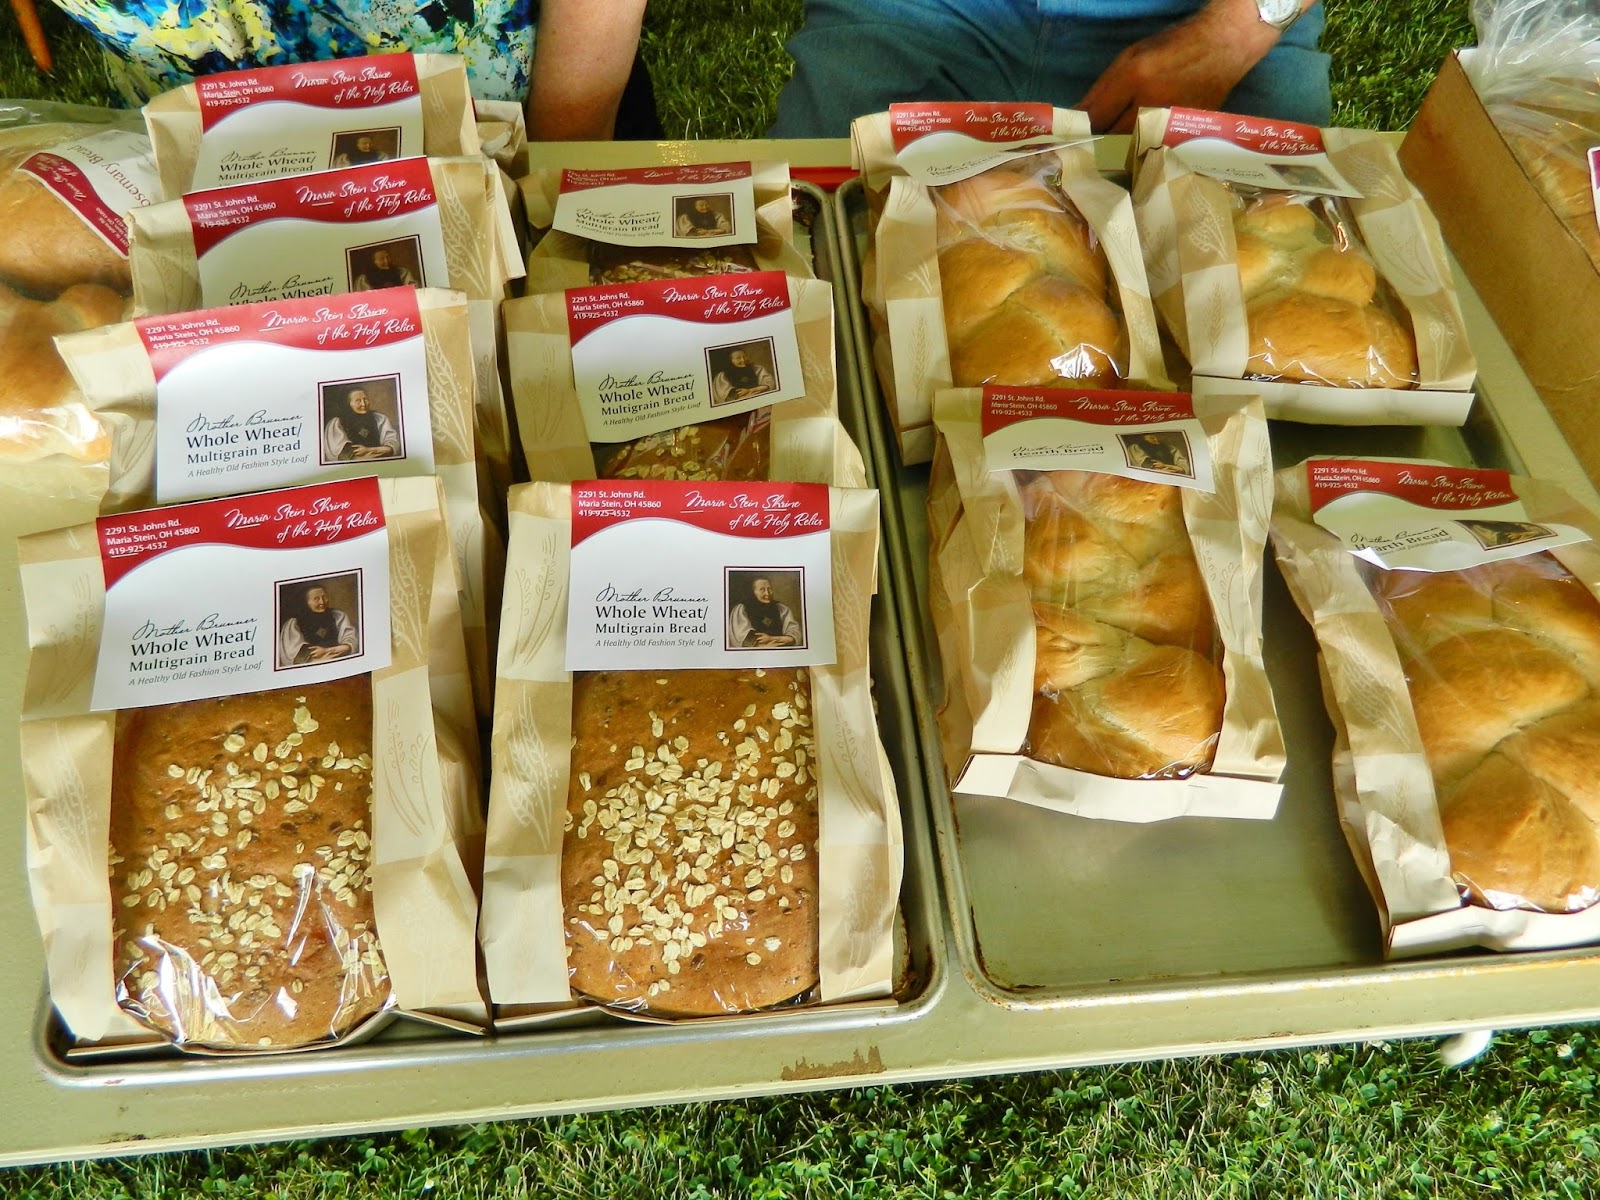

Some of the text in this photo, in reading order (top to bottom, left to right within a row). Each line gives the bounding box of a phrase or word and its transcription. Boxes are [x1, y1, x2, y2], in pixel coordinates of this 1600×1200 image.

[331, 71, 356, 85] Stein
[361, 67, 392, 81] Shrine
[335, 83, 414, 103] of the Holy Relics
[218, 165, 313, 181] Multigrain Bread
[220, 157, 315, 172] Whole Wheat/
[102, 163, 151, 207] osemary
[296, 176, 408, 203] Maria Stein Shrine
[194, 202, 212, 211] 2291
[213, 201, 223, 209] St.
[225, 198, 245, 206] Johns
[196, 212, 218, 220] Maria
[219, 208, 239, 218] Stein,
[254, 202, 276, 212] 45860
[344, 189, 431, 216] of the Holy Relics
[281, 283, 333, 302] Wheat/
[663, 284, 764, 302] Maria Stein Shrine
[574, 310, 619, 319] 419-925-4532
[592, 302, 611, 311] Stein,
[624, 299, 644, 307] 45860
[704, 296, 784, 318] of the Holy Relics
[262, 303, 389, 328] Maria Stein Shrine
[146, 325, 166, 334] 2291
[180, 321, 204, 331] Johns
[149, 325, 240, 342] Maria Stein, OH 45860
[317, 318, 415, 344] of the Holy Relics
[153, 338, 209, 350] 419-925-4532
[599, 379, 694, 404] Whole Wheat/
[601, 392, 694, 417] Multigrain Bread
[186, 423, 303, 449] Whole Wheat/
[187, 440, 300, 464] Multigrain Bread
[601, 500, 622, 508] Stein,
[684, 491, 801, 508] Maria Stein Shrine
[224, 498, 351, 528] Maria Stein Shrine
[578, 509, 630, 517] 419-925-4532
[105, 526, 127, 535] 2291
[129, 524, 139, 532] St.
[141, 522, 166, 531] Johns
[277, 512, 378, 543] of the Holy Relics
[730, 513, 823, 534] of the Holy Relics
[107, 526, 200, 545] Maria Stein, OH 45860
[109, 541, 167, 555] 419-925-4532
[595, 583, 709, 603] Mother Brunner
[595, 605, 708, 620] Whole Wheat/
[595, 623, 706, 636] Multigrain Bread
[131, 627, 256, 656] Whole Wheat/
[603, 640, 631, 648] Healthy
[678, 639, 695, 648] Style
[698, 639, 715, 648] Loaf
[129, 645, 255, 673] Multigrain Bread
[137, 674, 170, 686] Healthy
[172, 672, 186, 680] Old
[189, 667, 220, 678] Fashion
[222, 663, 242, 674] Style
[244, 660, 263, 672] Loaf
